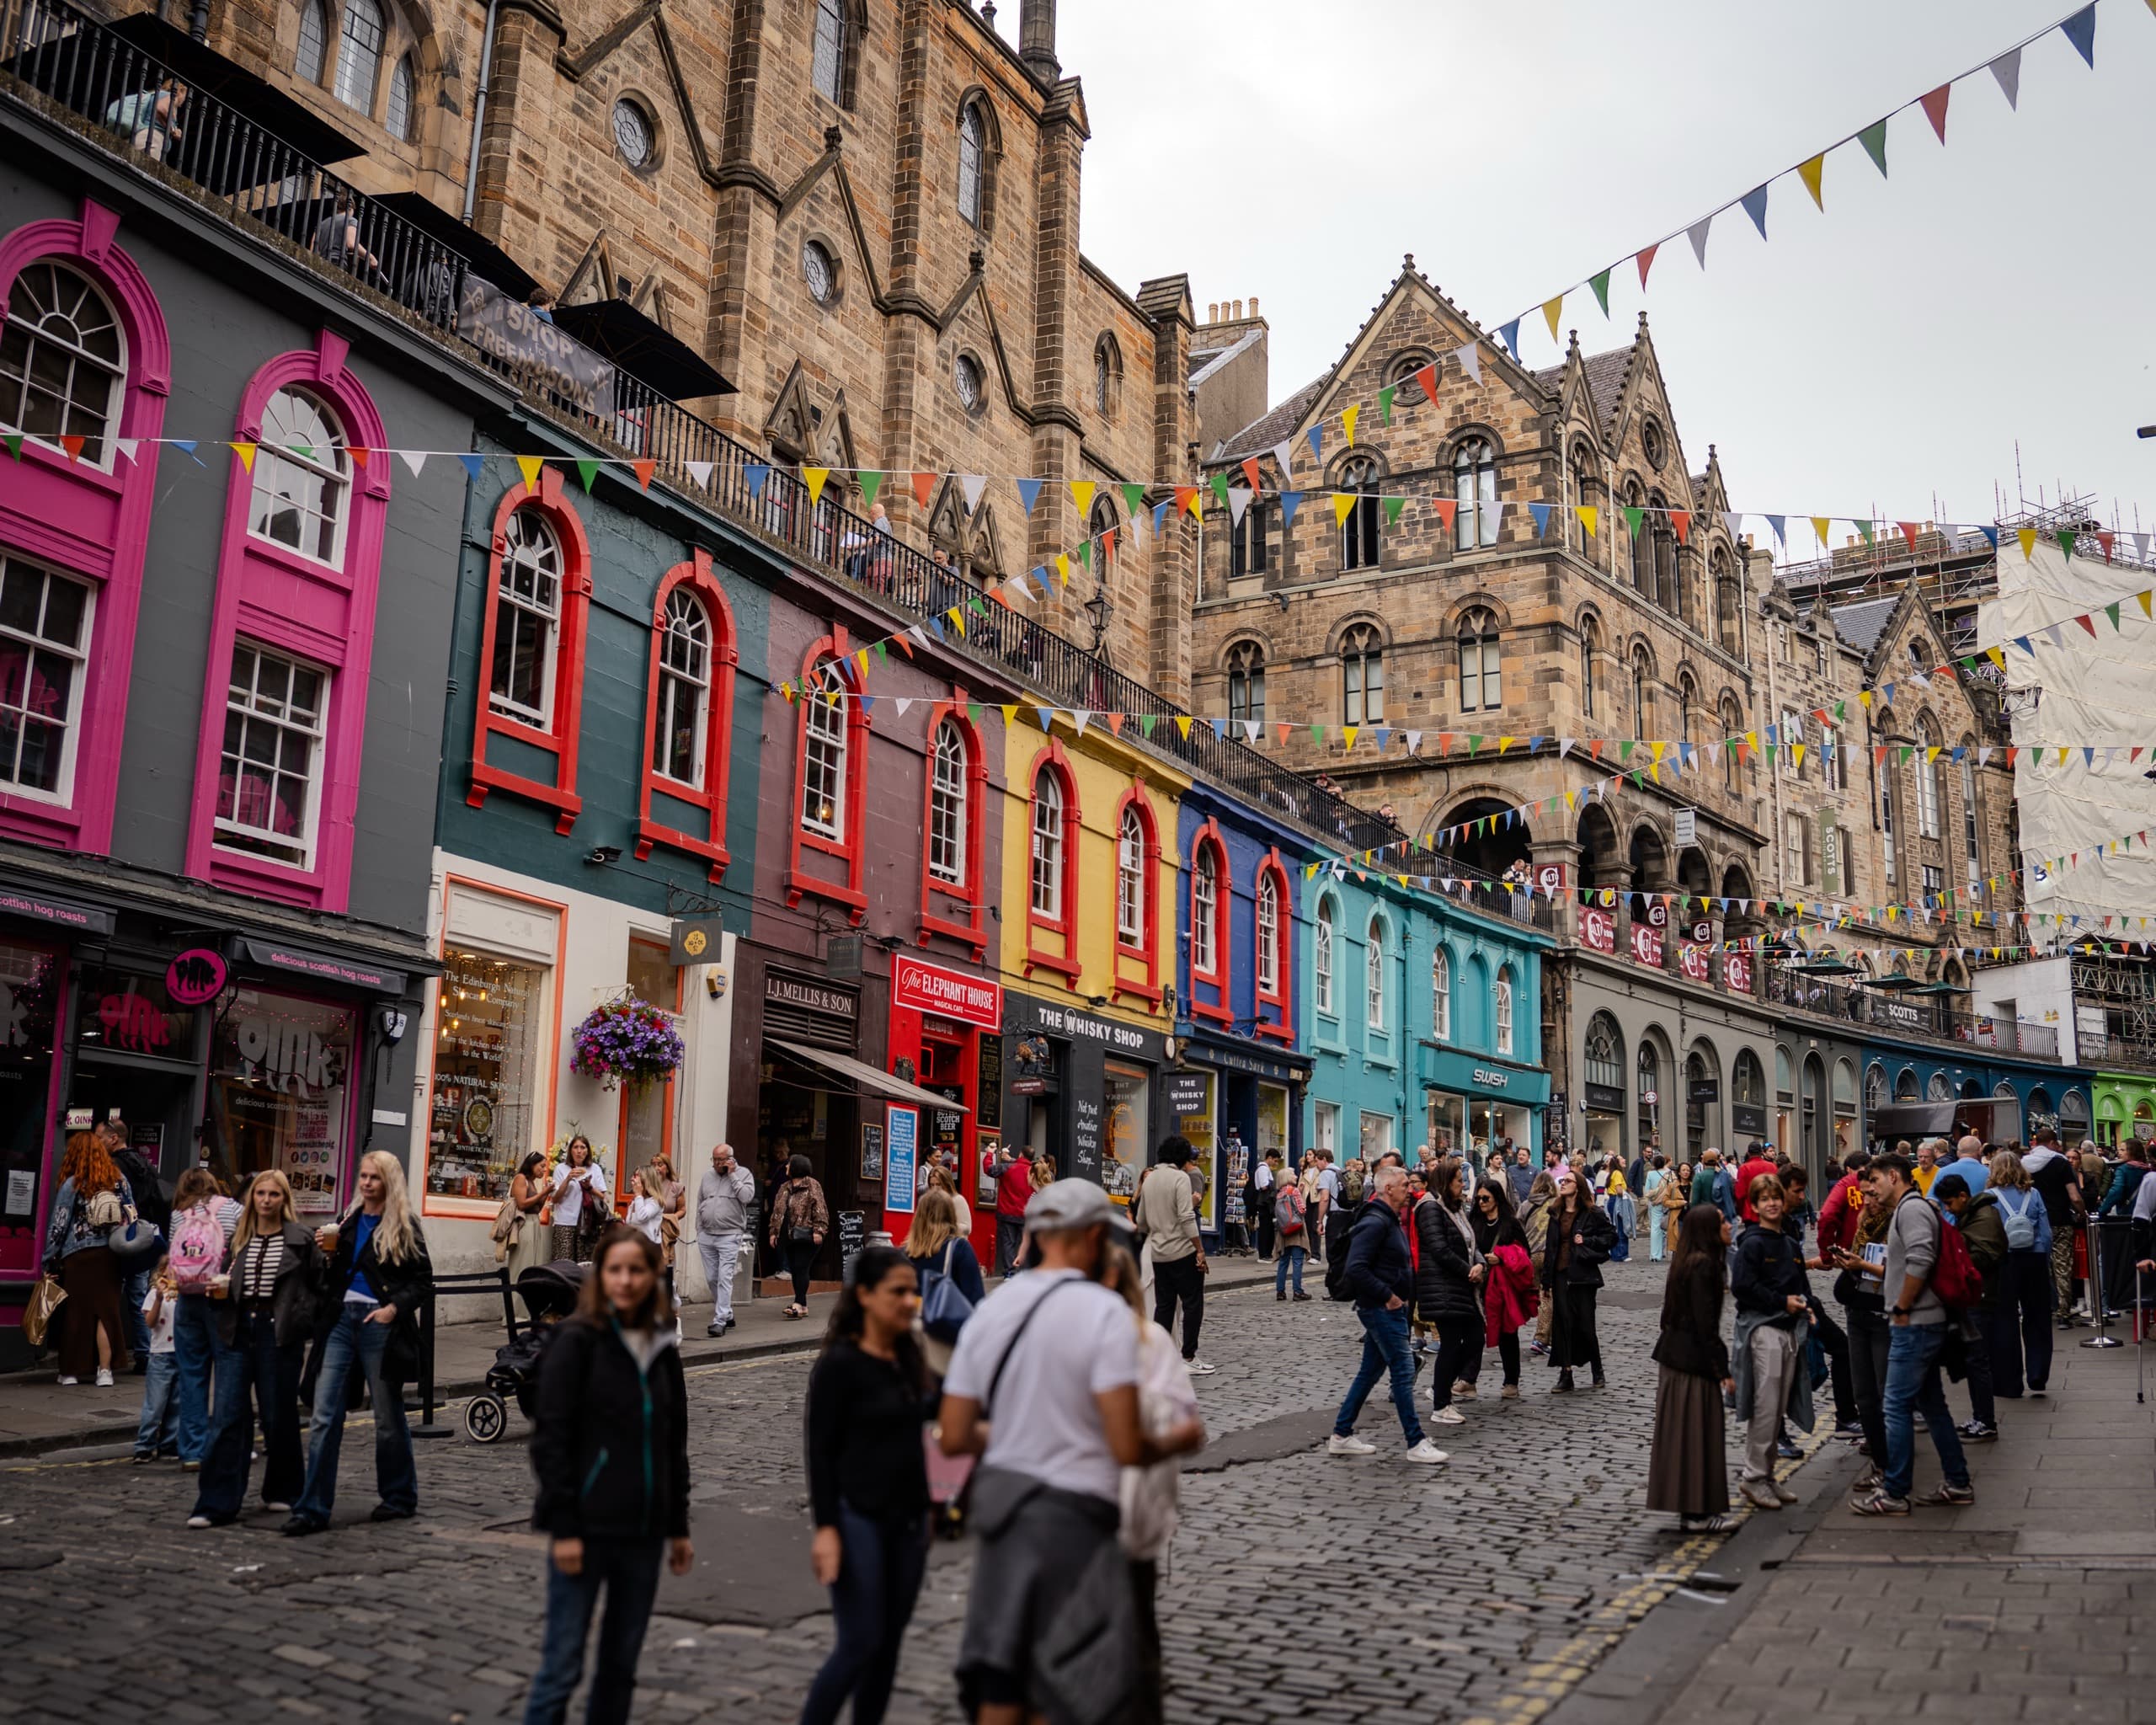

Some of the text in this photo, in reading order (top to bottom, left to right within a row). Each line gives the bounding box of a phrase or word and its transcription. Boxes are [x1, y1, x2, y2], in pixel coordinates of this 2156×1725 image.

[507, 304, 574, 359] SHOP
[472, 320, 595, 412] FREEMASONS
[1826, 826, 1836, 875] SCOTTS
[35, 902, 53, 917] hog
[56, 910, 87, 923] roasts
[271, 953, 381, 985] delicious scottish hog roasts
[445, 969, 459, 982] The
[462, 974, 500, 994] Edinburgh
[902, 967, 994, 1010] The ELEPHANT HOUSE
[486, 993, 520, 1011] Company
[822, 992, 828, 1007] &
[831, 995, 851, 1013] SON
[934, 1000, 953, 1011] MAGICAL
[1888, 1004, 1918, 1021] SCOTTS
[1038, 1007, 1144, 1049] THE WHISKY SHOP
[470, 1039, 489, 1049] kitchen
[472, 1050, 480, 1059] the
[453, 1076, 488, 1088] NATURAL
[1473, 1069, 1508, 1087] SWISH
[236, 1096, 265, 1108] delicious
[1171, 1091, 1204, 1100] WHISKY
[1078, 1100, 1087, 1113] Not
[937, 1114, 960, 1124] SCOTCH
[1077, 1119, 1097, 1132] Another
[456, 1145, 483, 1153] SYNTHETIC
[1077, 1134, 1097, 1154] Whisky
